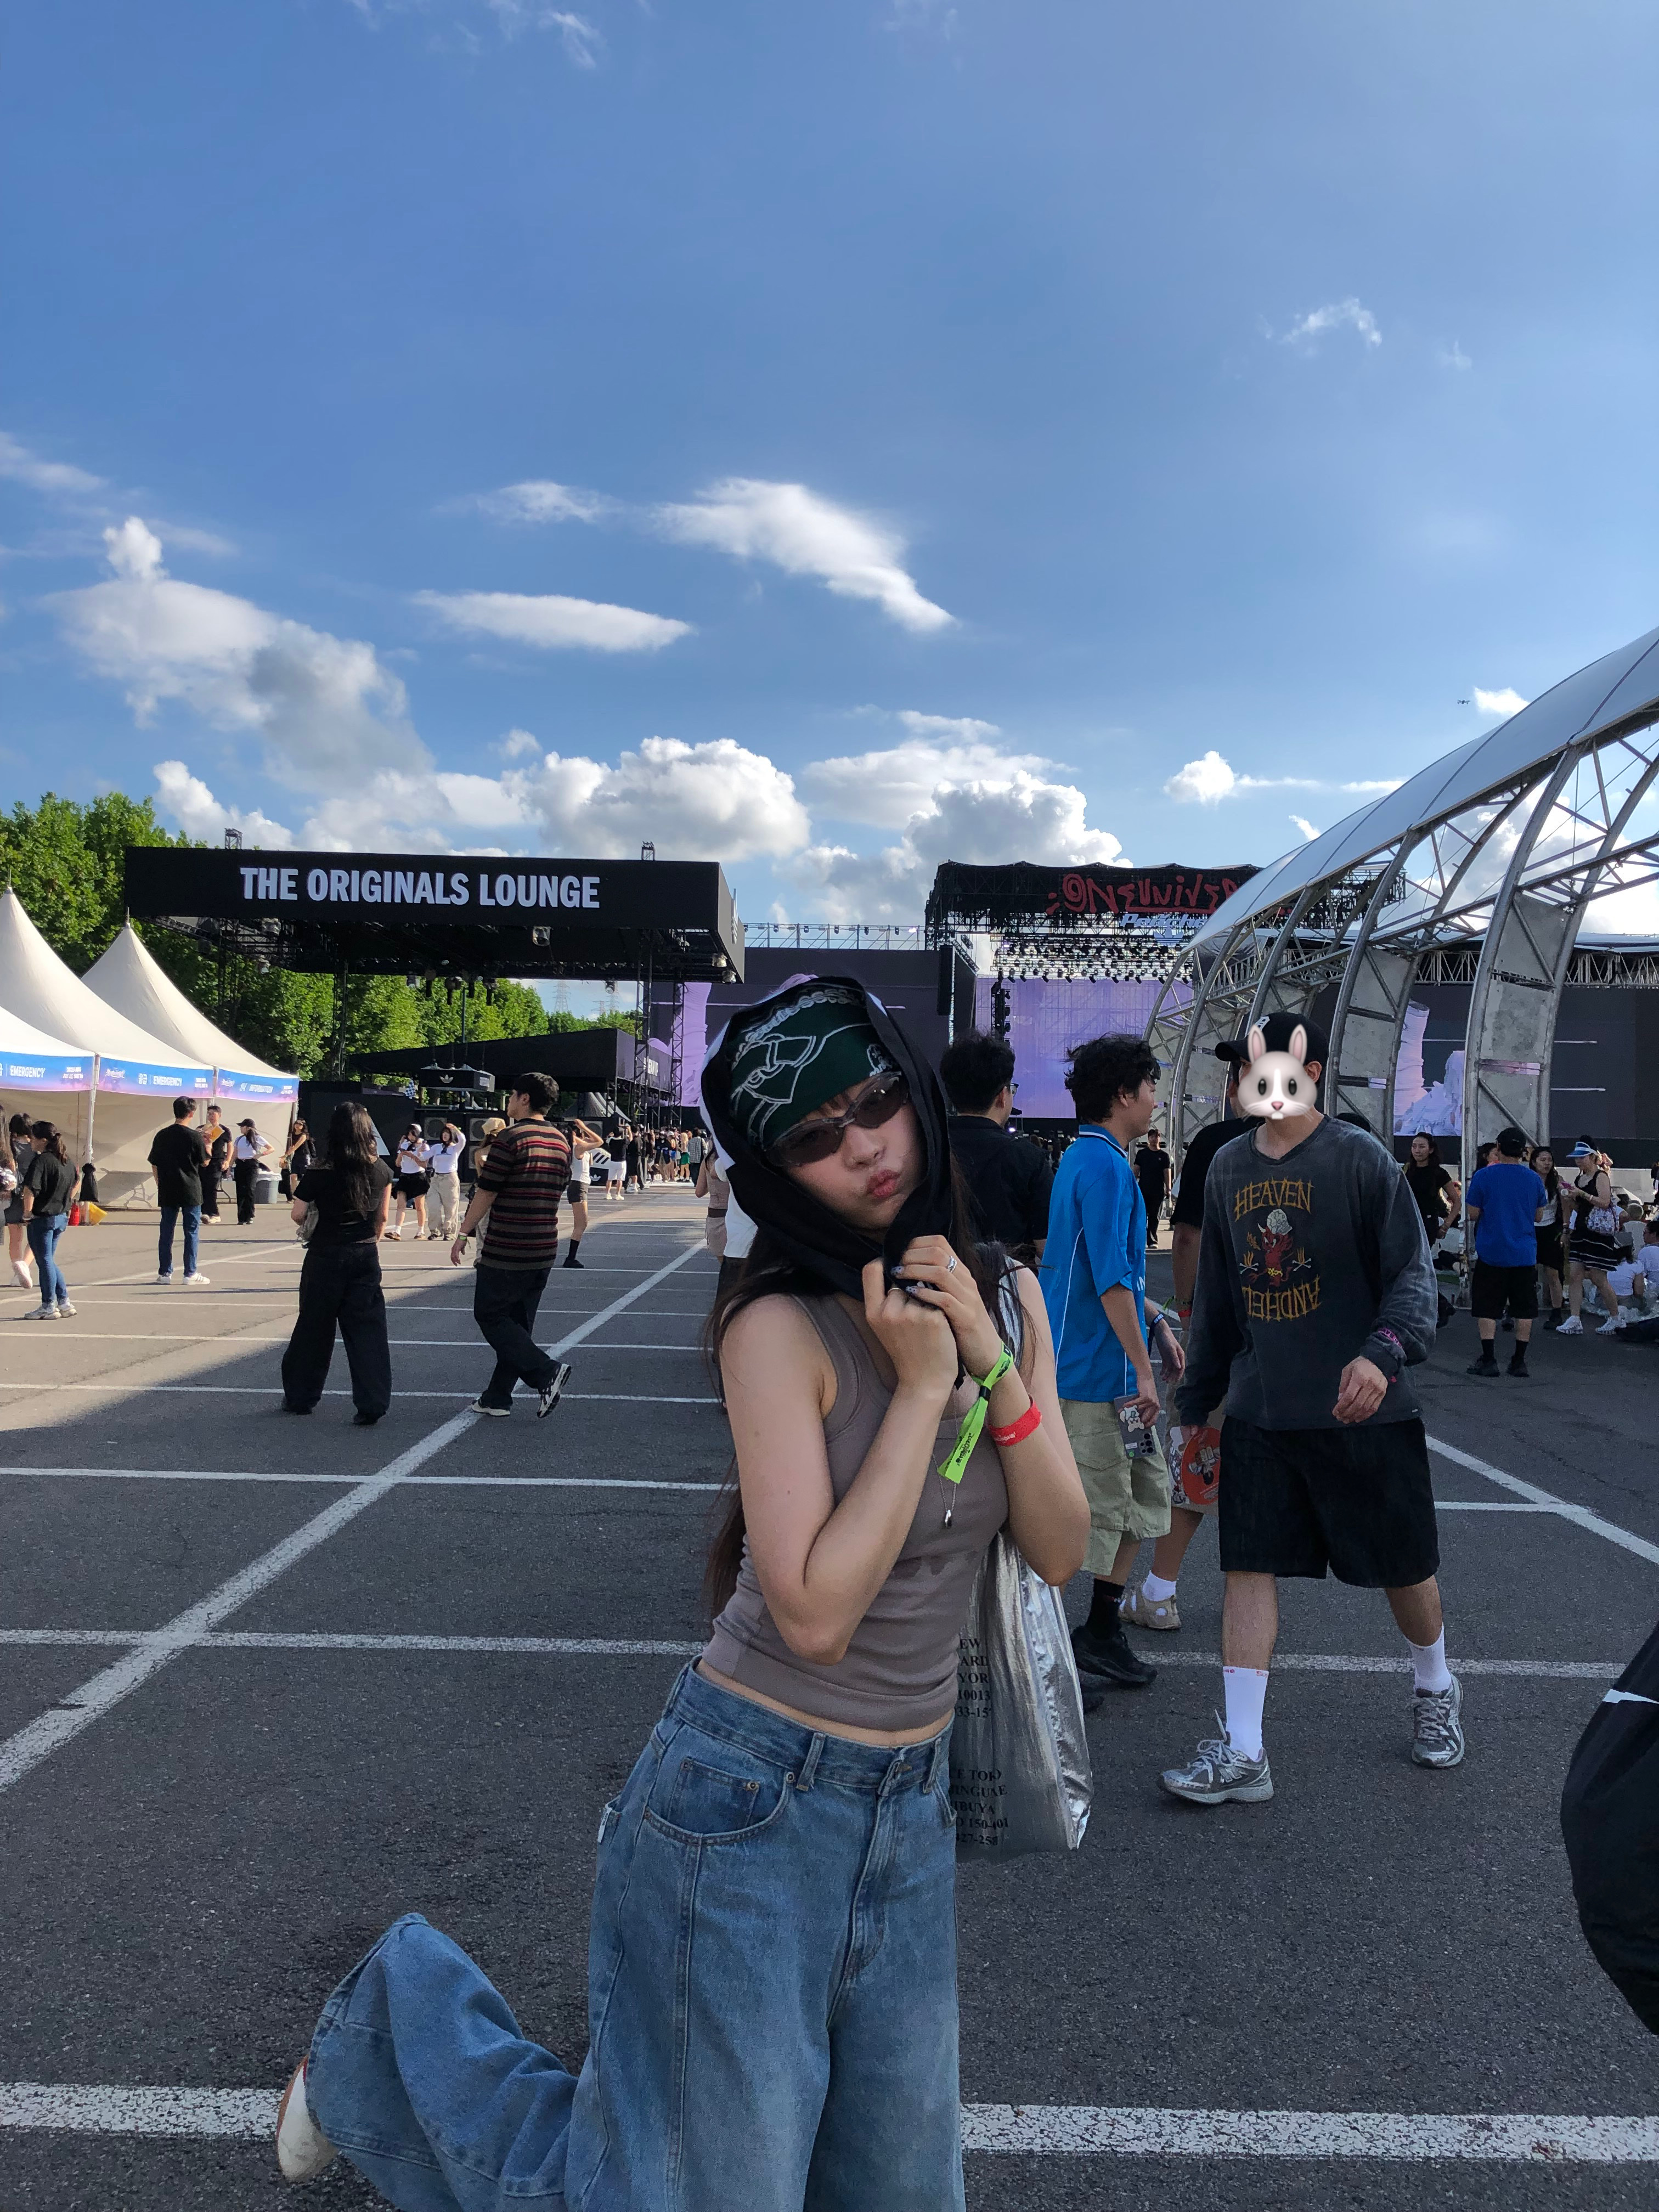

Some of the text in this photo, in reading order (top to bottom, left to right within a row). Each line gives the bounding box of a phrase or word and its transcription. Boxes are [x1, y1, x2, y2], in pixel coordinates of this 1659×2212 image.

[240, 867, 600, 908] THE ORIGINALS LOUNGE
[10, 1065, 46, 1078] EMERGENCY
[153, 1075, 182, 1086] EMERGENCY
[1234, 1175, 1314, 1222] HEAVEN
